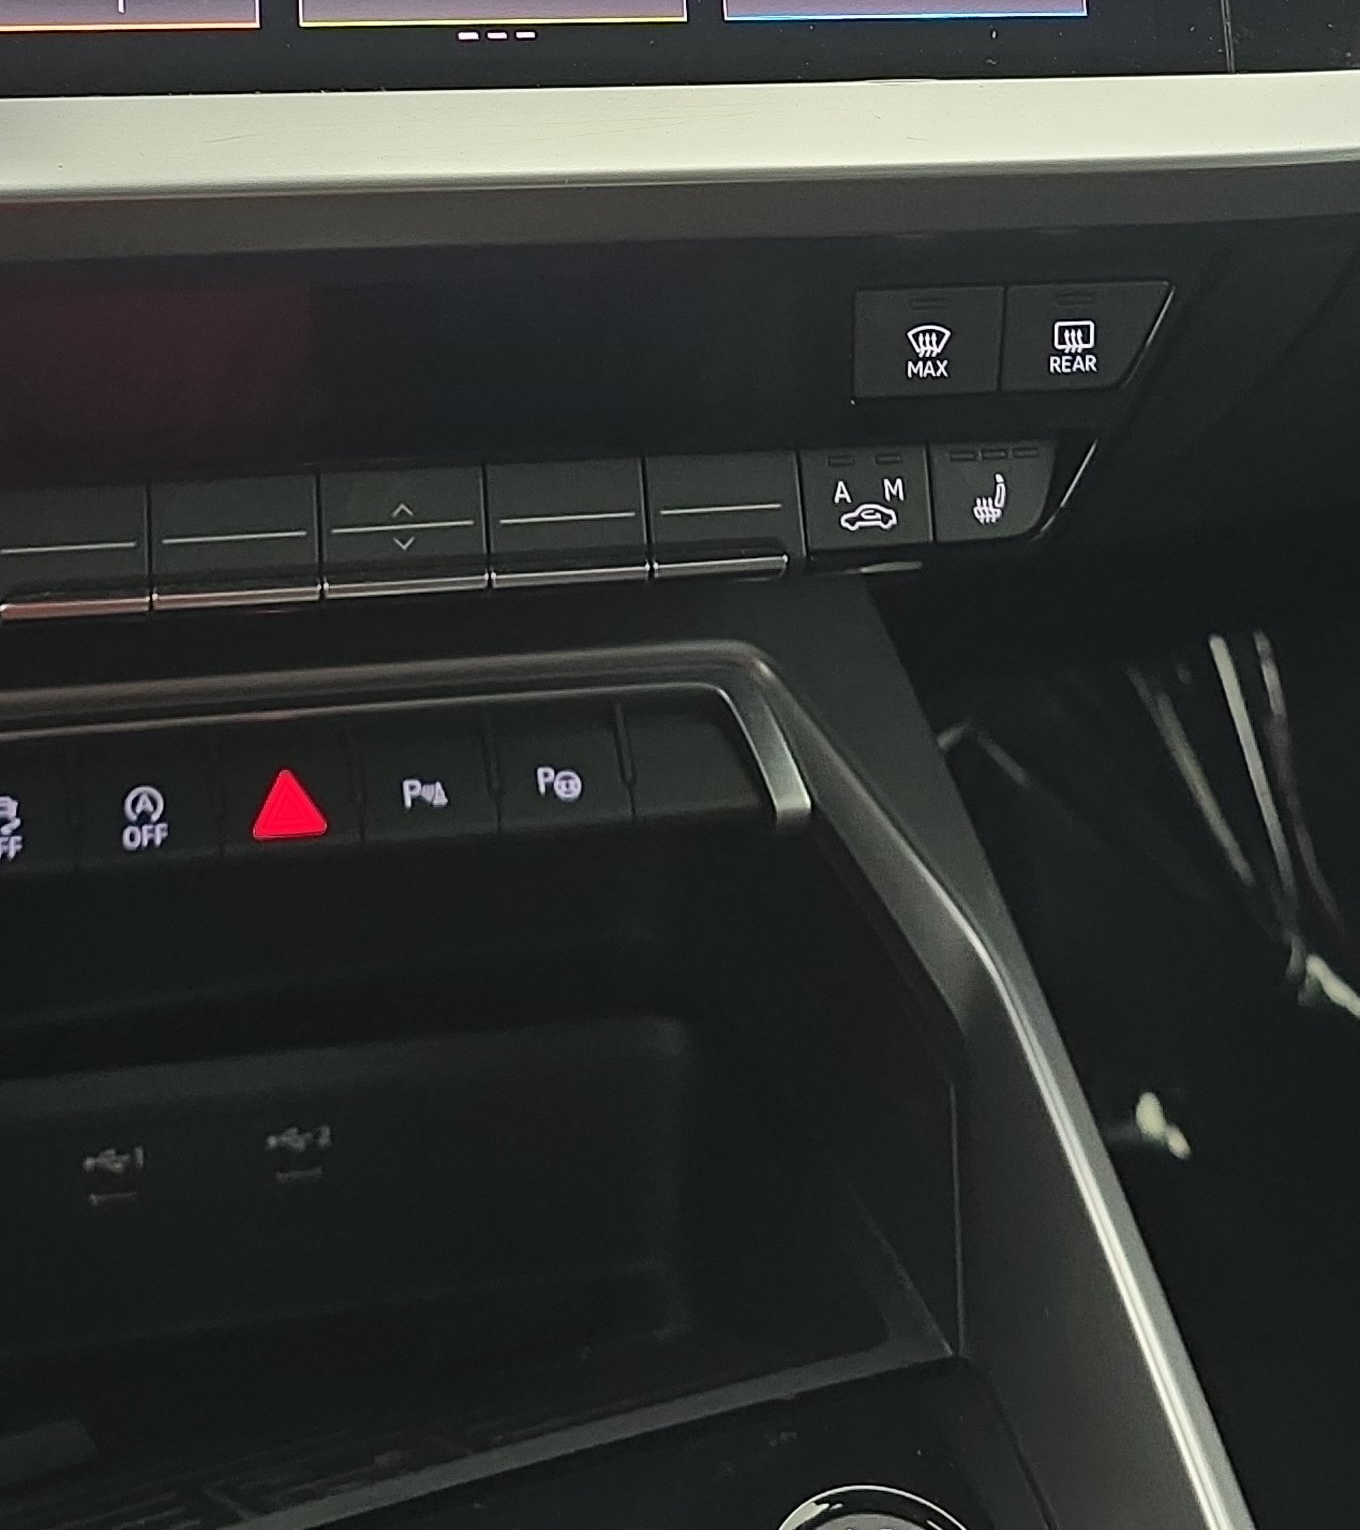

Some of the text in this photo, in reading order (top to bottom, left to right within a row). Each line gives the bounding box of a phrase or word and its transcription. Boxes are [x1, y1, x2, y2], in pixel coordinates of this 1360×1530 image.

[907, 359, 949, 378] MAX
[1049, 354, 1097, 374] REAR
[834, 478, 904, 504] A M
[122, 825, 168, 850] OFF
